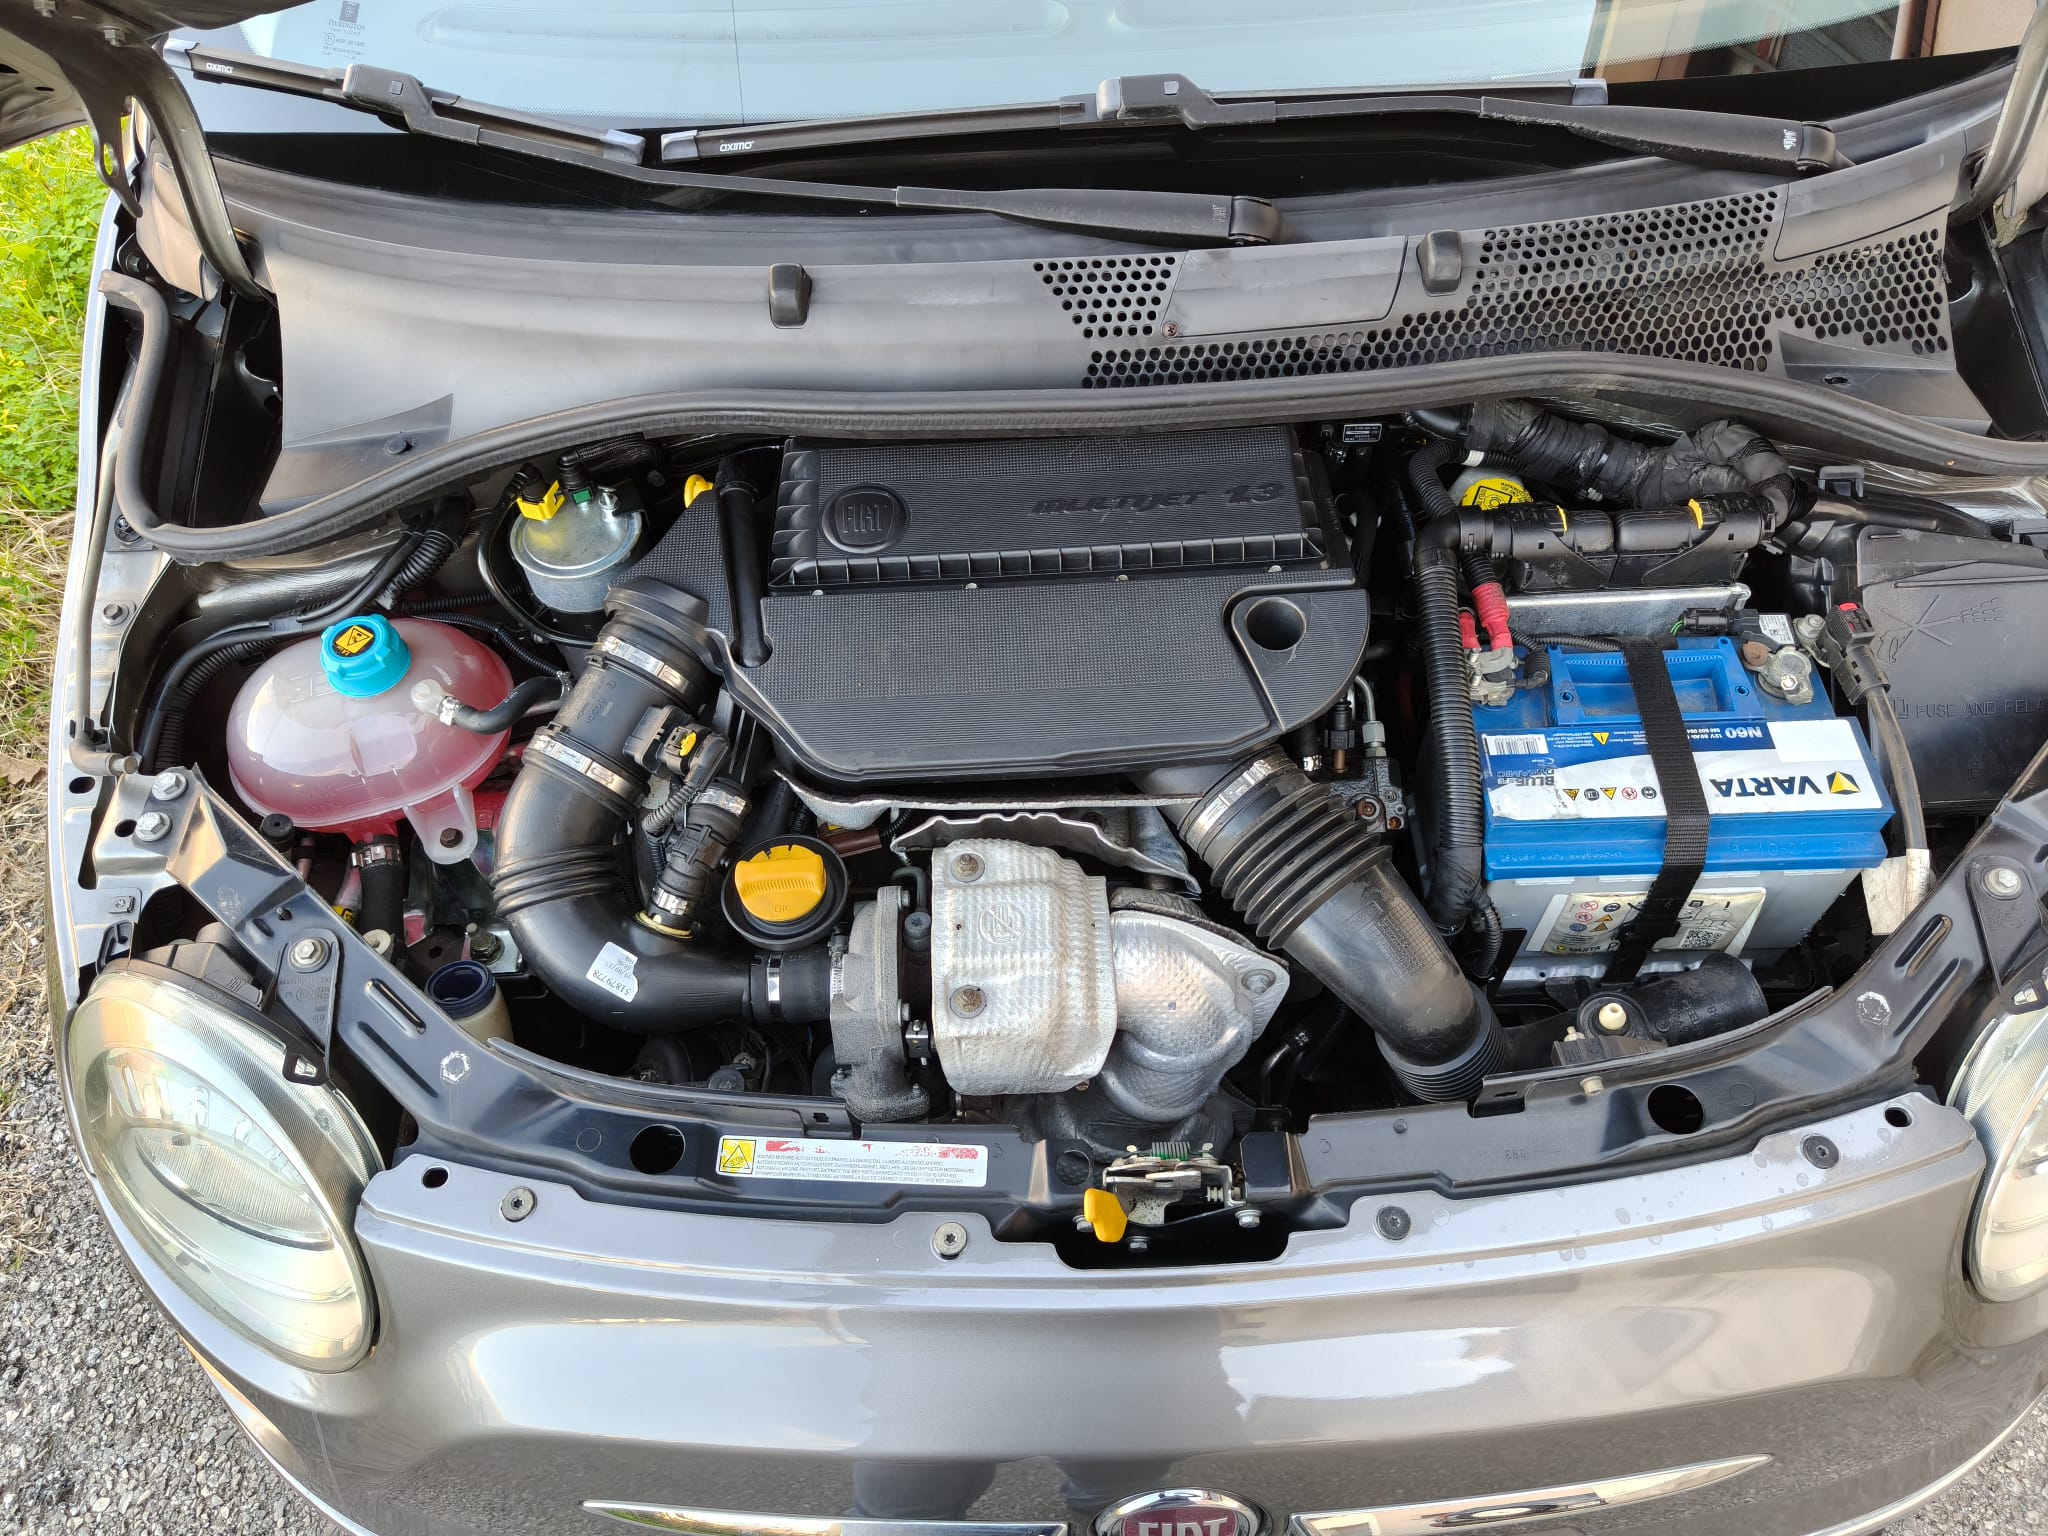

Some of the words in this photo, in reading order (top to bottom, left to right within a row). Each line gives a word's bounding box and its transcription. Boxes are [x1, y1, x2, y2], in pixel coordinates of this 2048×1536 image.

[842, 504, 888, 533] FIAT
[1916, 703, 1957, 718] FUSE
[1963, 701, 1998, 716] AND
[1725, 726, 1764, 739] N60
[1515, 775, 1555, 787] BLUE
[1709, 775, 1823, 798] VARTA
